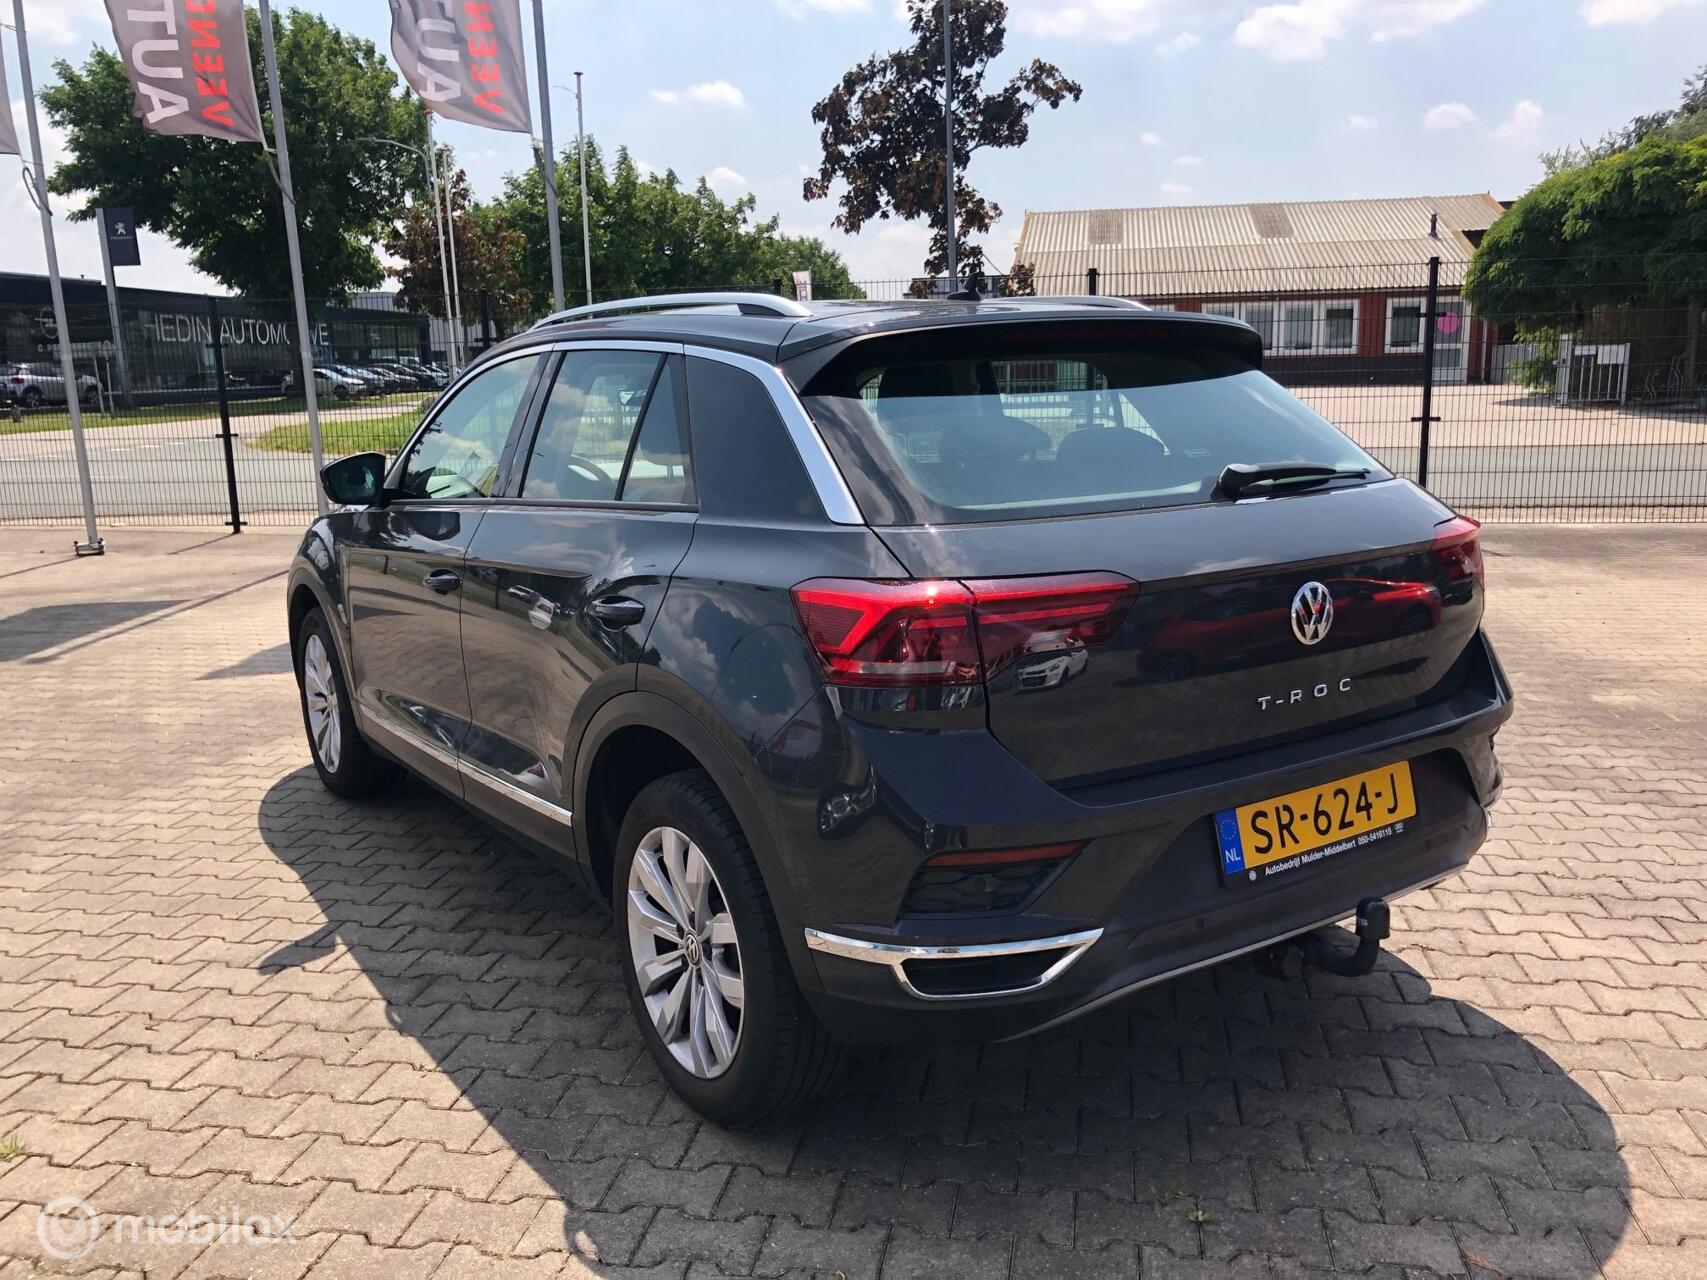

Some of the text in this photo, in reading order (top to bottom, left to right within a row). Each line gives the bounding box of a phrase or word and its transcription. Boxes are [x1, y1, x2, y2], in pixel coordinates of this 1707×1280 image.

[220, 317, 330, 346] AUTOMVE
[1257, 678, 1351, 710] T-ROC
[1225, 773, 1399, 864] NL SR-624-J
[1265, 855, 1300, 876] Autobedrijf
[1301, 840, 1356, 864] Mulder-Middelbert
